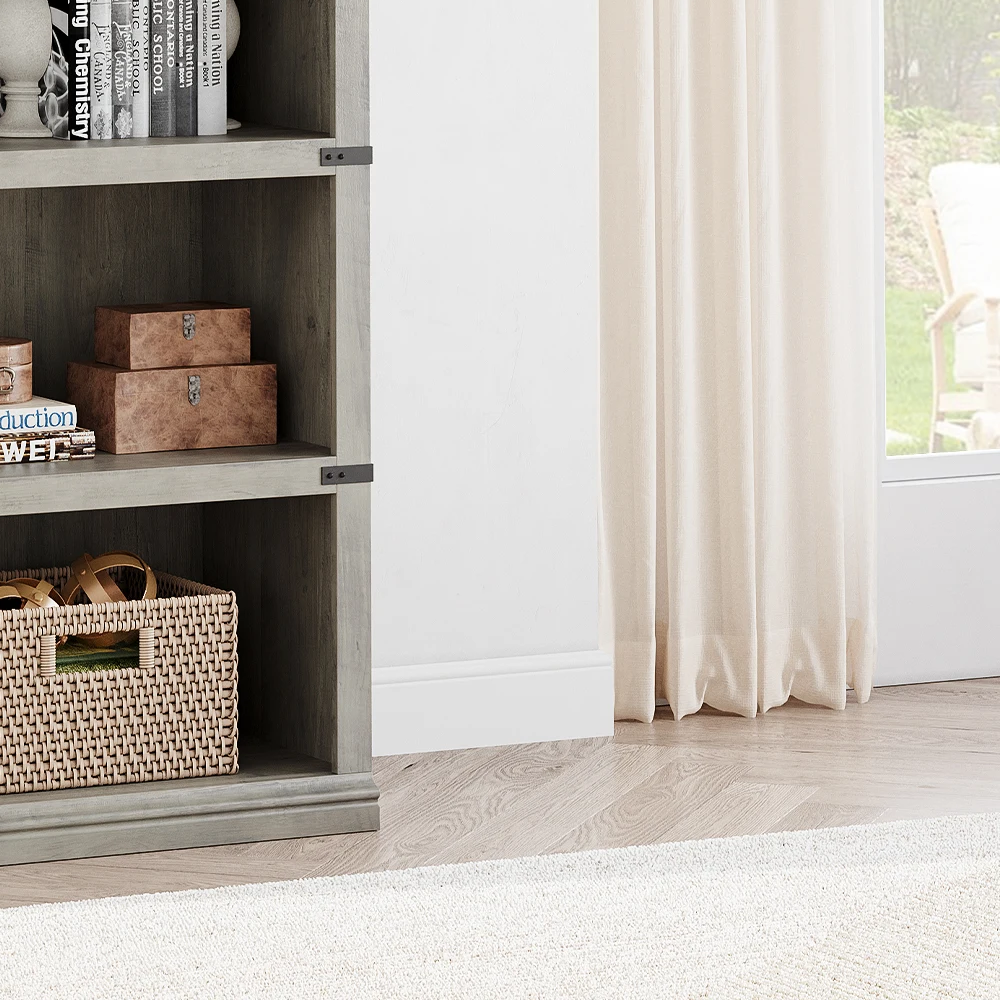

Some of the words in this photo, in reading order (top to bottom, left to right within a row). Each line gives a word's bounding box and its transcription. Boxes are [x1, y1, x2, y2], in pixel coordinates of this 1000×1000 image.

[211, 33, 220, 41] a
[124, 80, 131, 89] &
[132, 40, 140, 97] SCHOOL
[153, 34, 163, 95] SCHOOL
[185, 45, 194, 87] Nation
[211, 44, 222, 87] Nation
[71, 38, 90, 139] Chemistry
